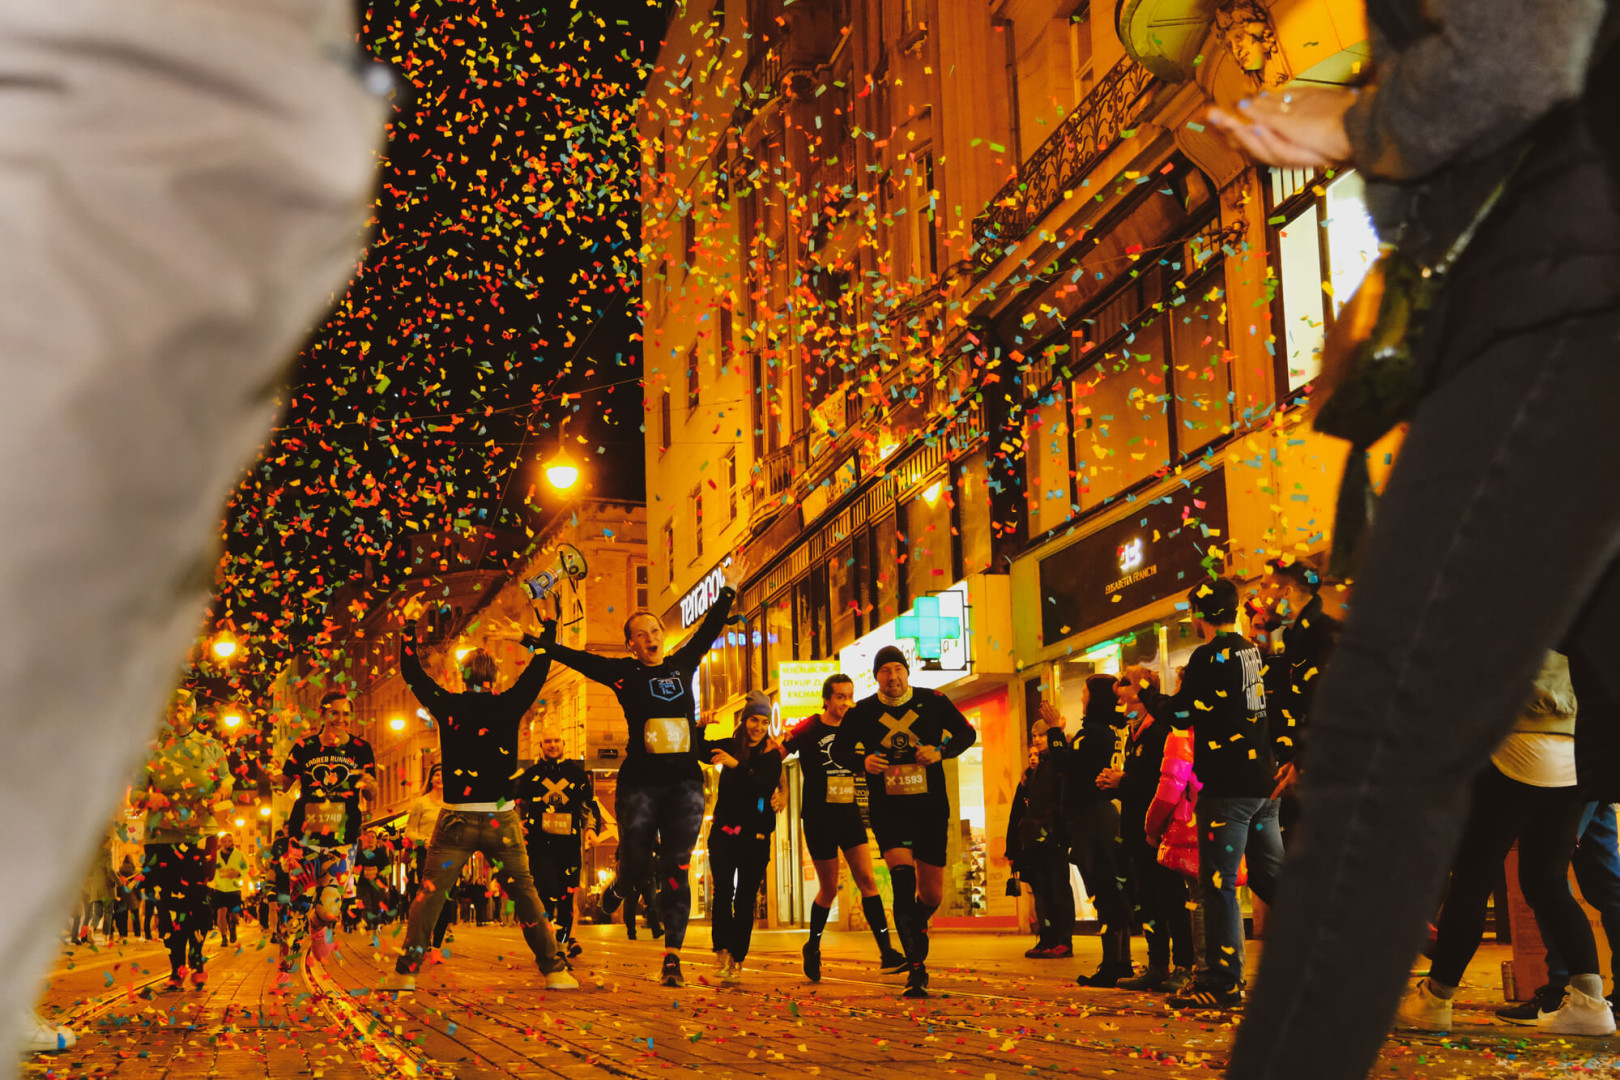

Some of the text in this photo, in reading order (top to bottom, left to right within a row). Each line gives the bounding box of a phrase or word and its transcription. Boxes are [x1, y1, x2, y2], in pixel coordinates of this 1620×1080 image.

[1133, 564, 1157, 583] FRANCHI
[783, 679, 811, 687] OTKUP
[788, 690, 822, 698] EXCHAN
